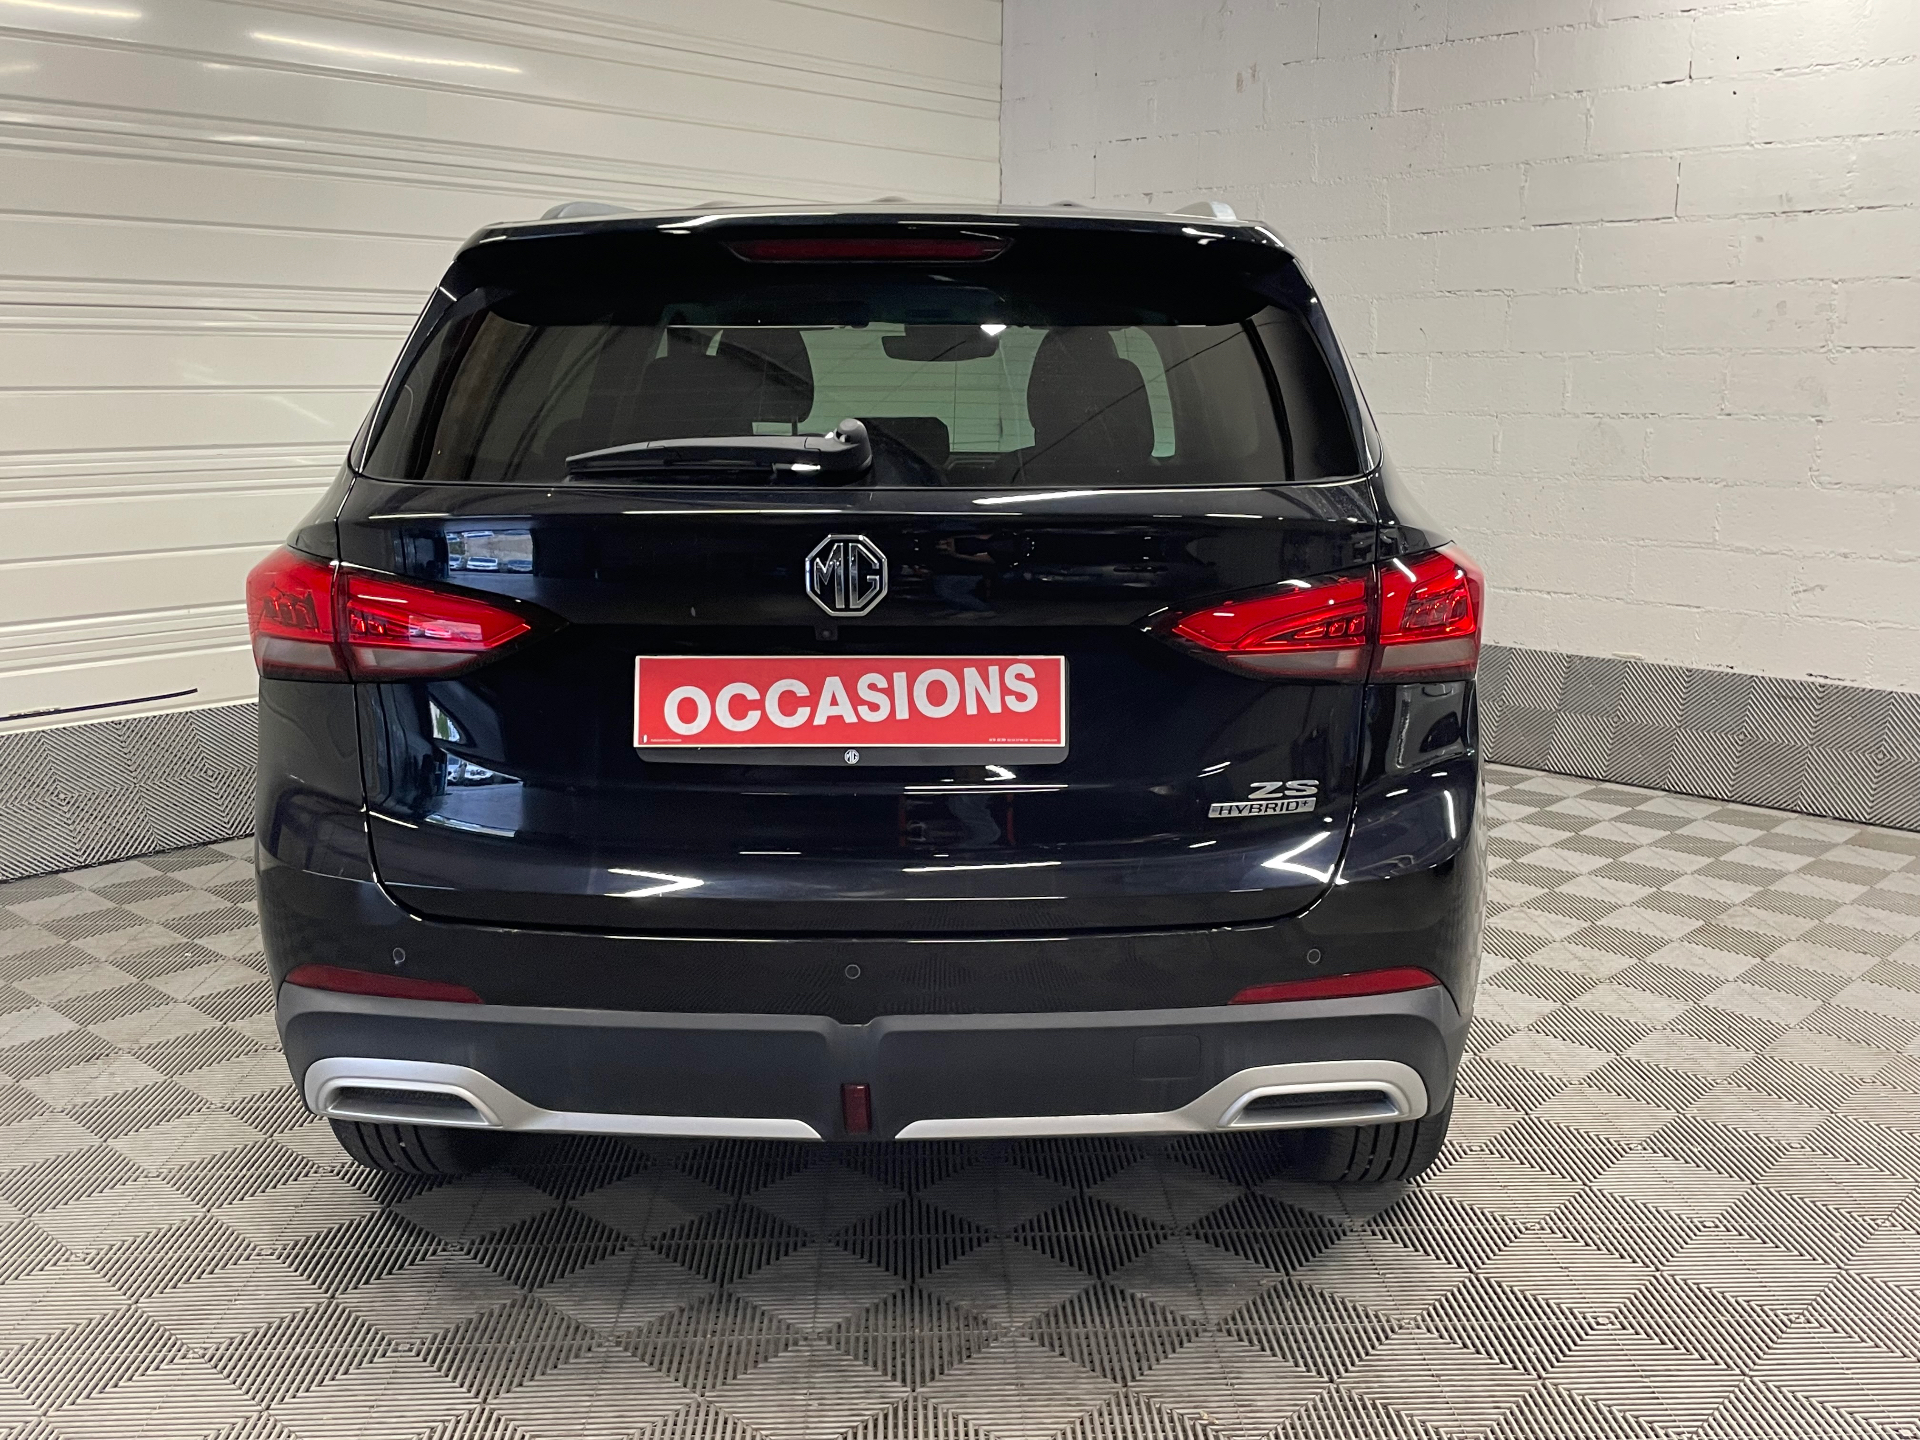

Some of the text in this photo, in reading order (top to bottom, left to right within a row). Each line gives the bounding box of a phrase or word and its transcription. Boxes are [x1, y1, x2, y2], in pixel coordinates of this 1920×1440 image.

[813, 542, 881, 609] MG
[663, 663, 1039, 736] OCCASIONS
[1248, 780, 1319, 799] ZS
